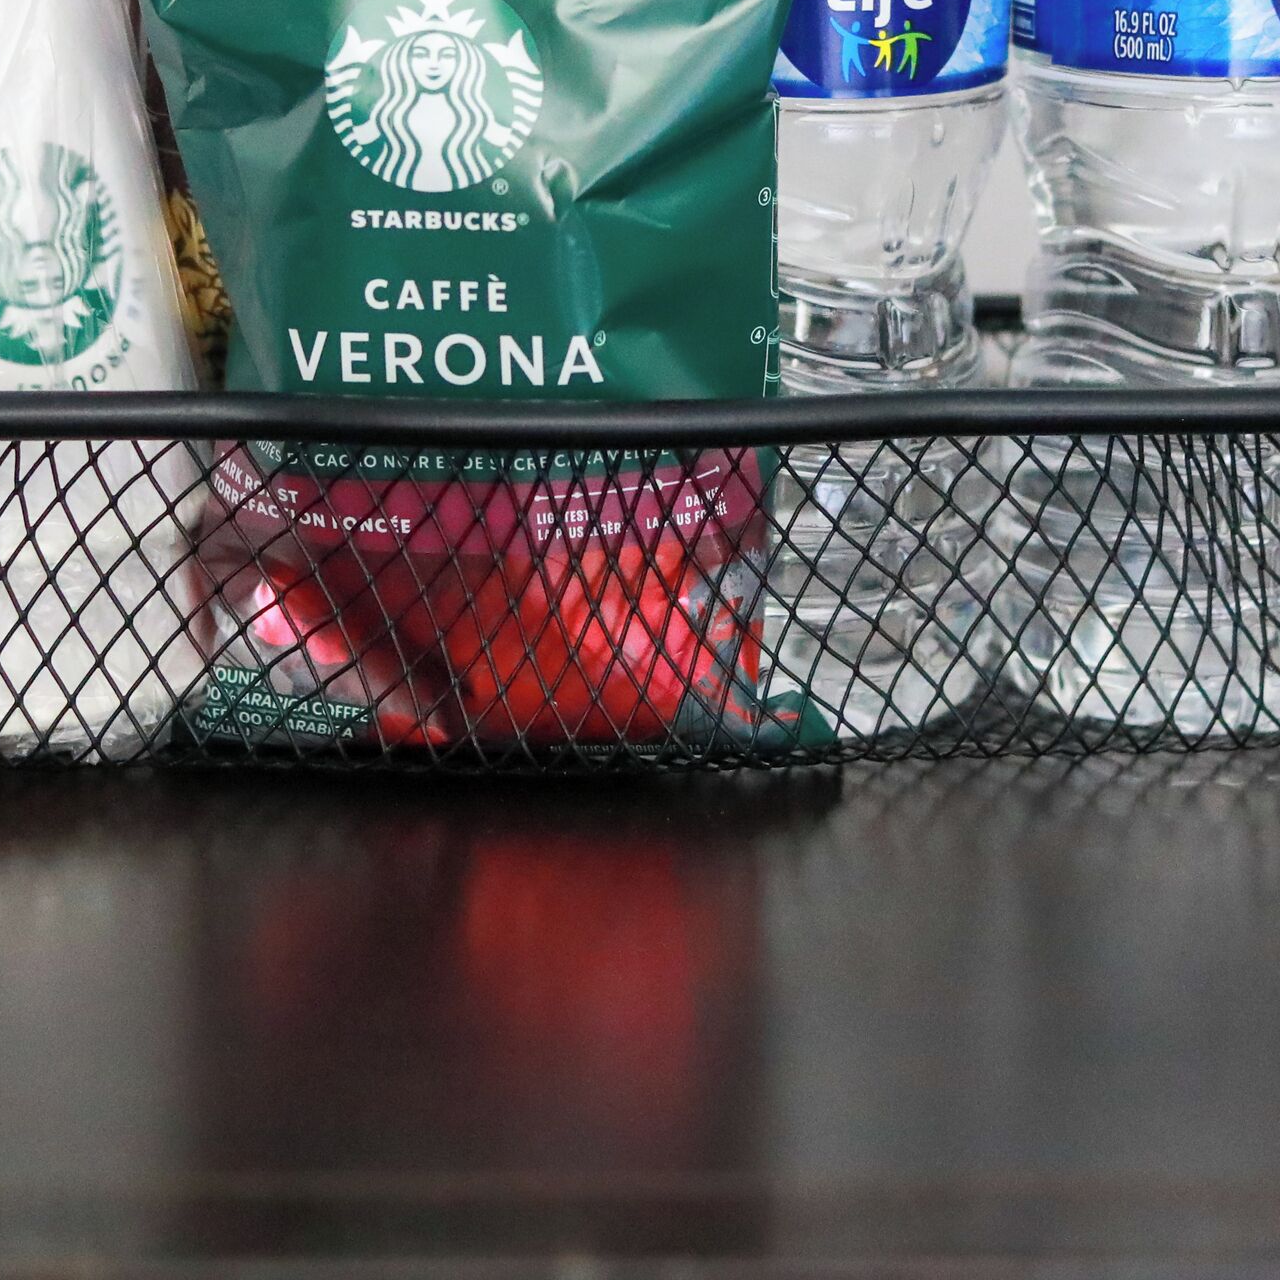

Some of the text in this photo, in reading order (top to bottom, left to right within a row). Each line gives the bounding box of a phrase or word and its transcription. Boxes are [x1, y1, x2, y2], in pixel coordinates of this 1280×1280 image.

[1114, 9, 1177, 36] 16.9 FL OZ
[1114, 33, 1172, 62] (500 mL)
[364, 273, 508, 313] CAFFÈ
[314, 453, 377, 468] CACO
[555, 525, 584, 540] PUS
